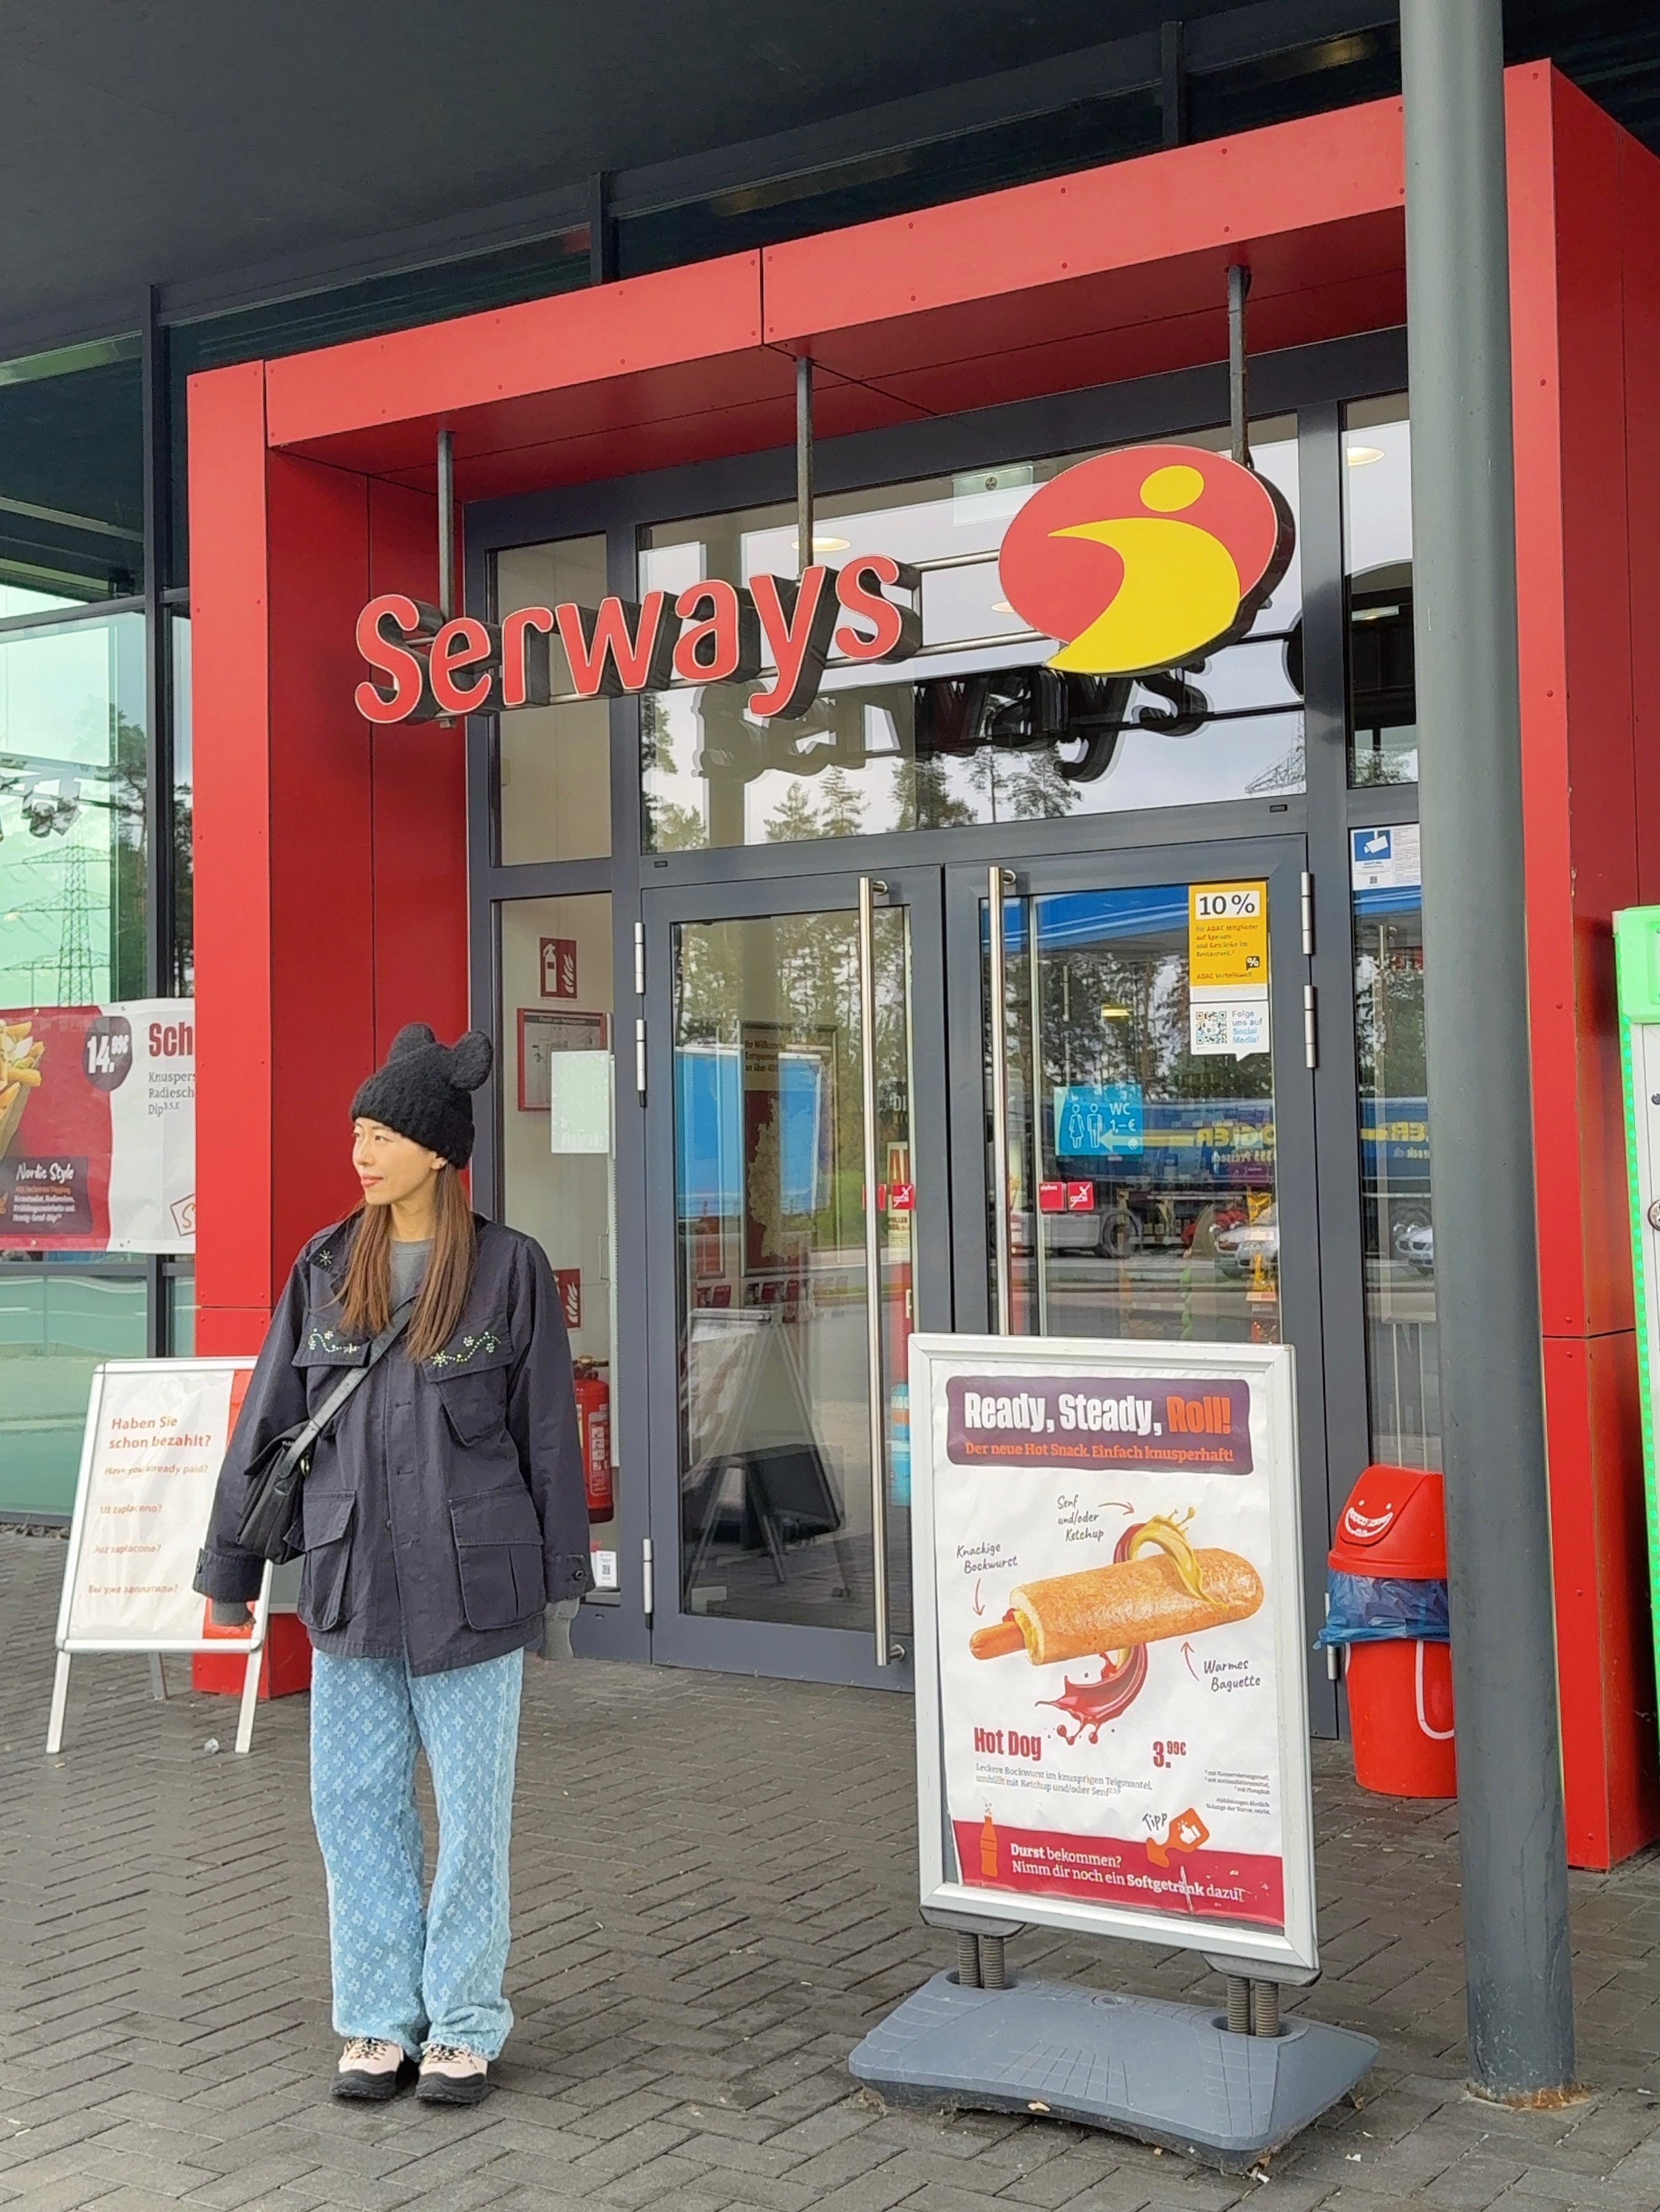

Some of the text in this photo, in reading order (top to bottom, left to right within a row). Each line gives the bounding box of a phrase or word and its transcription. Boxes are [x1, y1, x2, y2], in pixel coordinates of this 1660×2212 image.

[355, 553, 908, 725] Serways
[1199, 896, 1226, 915] 10
[1232, 1010, 1254, 1018] Folge
[1109, 1102, 1131, 1116] WC
[15, 1161, 75, 1184] Nordic Style
[111, 1415, 178, 1430] Haben Sie
[964, 1392, 1231, 1436] Ready, Steady, Roll!
[108, 1433, 212, 1449] schon bezahlt?
[965, 1441, 1234, 1464] Der neue Hot Snack. Einfach knusperhaft!
[182, 1463, 209, 1475] paid?
[1057, 1493, 1079, 1510] Senf
[1057, 1510, 1099, 1526] und/oder
[1066, 1527, 1104, 1542] Ketchup
[963, 1555, 1019, 1574] Bockwurst
[1204, 1659, 1249, 1674] Warmes
[1211, 1675, 1261, 1693] Baguette
[973, 1726, 1042, 1761] Hot Dog
[976, 1762, 1153, 1791] Leckere Bockwurst im knusprigen Teigmantel,
[1052, 1784, 1090, 1795] und/oder
[1141, 1812, 1168, 1832] Tipp
[1010, 1842, 1122, 1869] Durst bekommen?
[1011, 1860, 1245, 1903] Nimm dir noch ein Softgetränk dazu!
